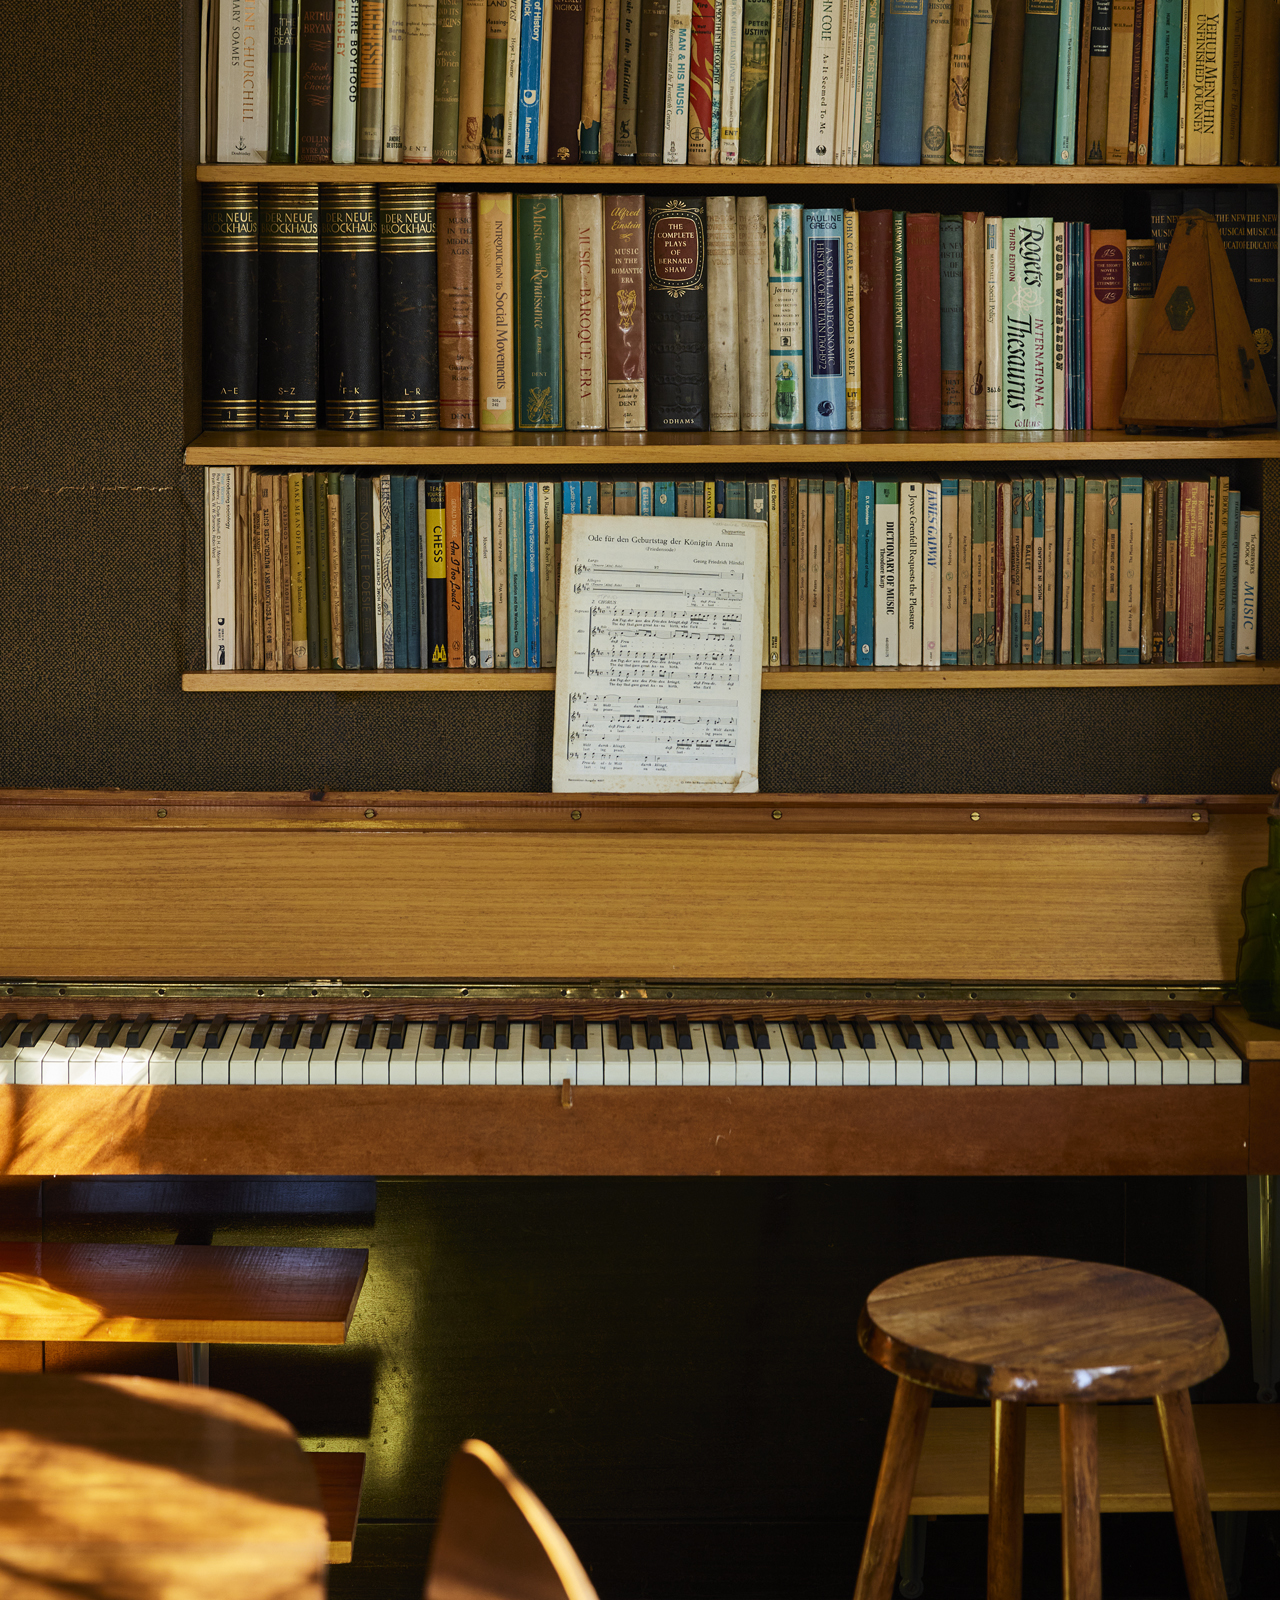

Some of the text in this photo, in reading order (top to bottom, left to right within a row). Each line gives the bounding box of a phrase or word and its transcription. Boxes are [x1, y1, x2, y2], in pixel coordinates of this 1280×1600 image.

[532, 14, 541, 41] History
[821, 19, 832, 42] COLE
[232, 26, 240, 66] SOAMES
[823, 54, 829, 65] As
[243, 36, 255, 123] CHURCHILL
[349, 40, 358, 103] BOYHOOD
[622, 58, 631, 105] Multitude
[677, 64, 685, 81] HIS
[865, 22, 877, 124] STILL GLIDES THE STREAM
[1194, 14, 1206, 134] UNFINISHED JOURNEY
[1204, 14, 1219, 134] YEHUDI MENUHIN
[676, 84, 684, 115] MUSIC
[819, 121, 825, 134] Me
[820, 110, 826, 119] To
[208, 213, 252, 222] DER NEUE
[265, 213, 313, 223] DER NEUE
[326, 212, 373, 222] DER NEUE
[386, 212, 432, 223] DER NEUE
[532, 203, 546, 242] Music
[611, 208, 641, 219] Alfred
[611, 220, 641, 230] Einstein
[810, 222, 836, 230] GREGG
[1247, 214, 1277, 222] THE NEW
[204, 222, 257, 233] BROCKHAUS
[261, 222, 318, 234] BROCKHAUS
[322, 222, 377, 233] BROCKHAUS
[381, 223, 437, 234] BROCKHAUS
[894, 219, 902, 254] HARMONY
[826, 256, 834, 290] SOCIAL
[530, 267, 549, 329] Renaissance
[817, 243, 827, 370] HISTORY OF BRITAIN 1760-1972
[895, 273, 903, 328] COUNTERPOINT
[578, 228, 591, 399] MUSIC BAROQUE ERA
[827, 315, 835, 366] ECONOMIC
[848, 336, 854, 344] IS
[1006, 315, 1032, 411] Thesaurus
[1035, 319, 1044, 408] INTERNATIONAL
[1014, 419, 1041, 428] Collins
[295, 504, 300, 516] ME
[908, 494, 917, 515] Joyce
[296, 519, 300, 528] AN
[360, 512, 369, 559] NOVELLE
[927, 489, 938, 568] JAMES GALWAY
[433, 526, 442, 563] CHESS
[450, 541, 459, 556] Am
[632, 537, 668, 546] Geburtstag
[684, 538, 713, 547] Königin
[451, 567, 460, 580] Too
[886, 522, 894, 615] DICTIONARY OF MUSIC
[908, 549, 917, 582] Requests
[361, 576, 371, 611] POESIE
[909, 583, 917, 596] the
[909, 598, 917, 630] Pleasure
[1244, 581, 1254, 630] MUSIC
